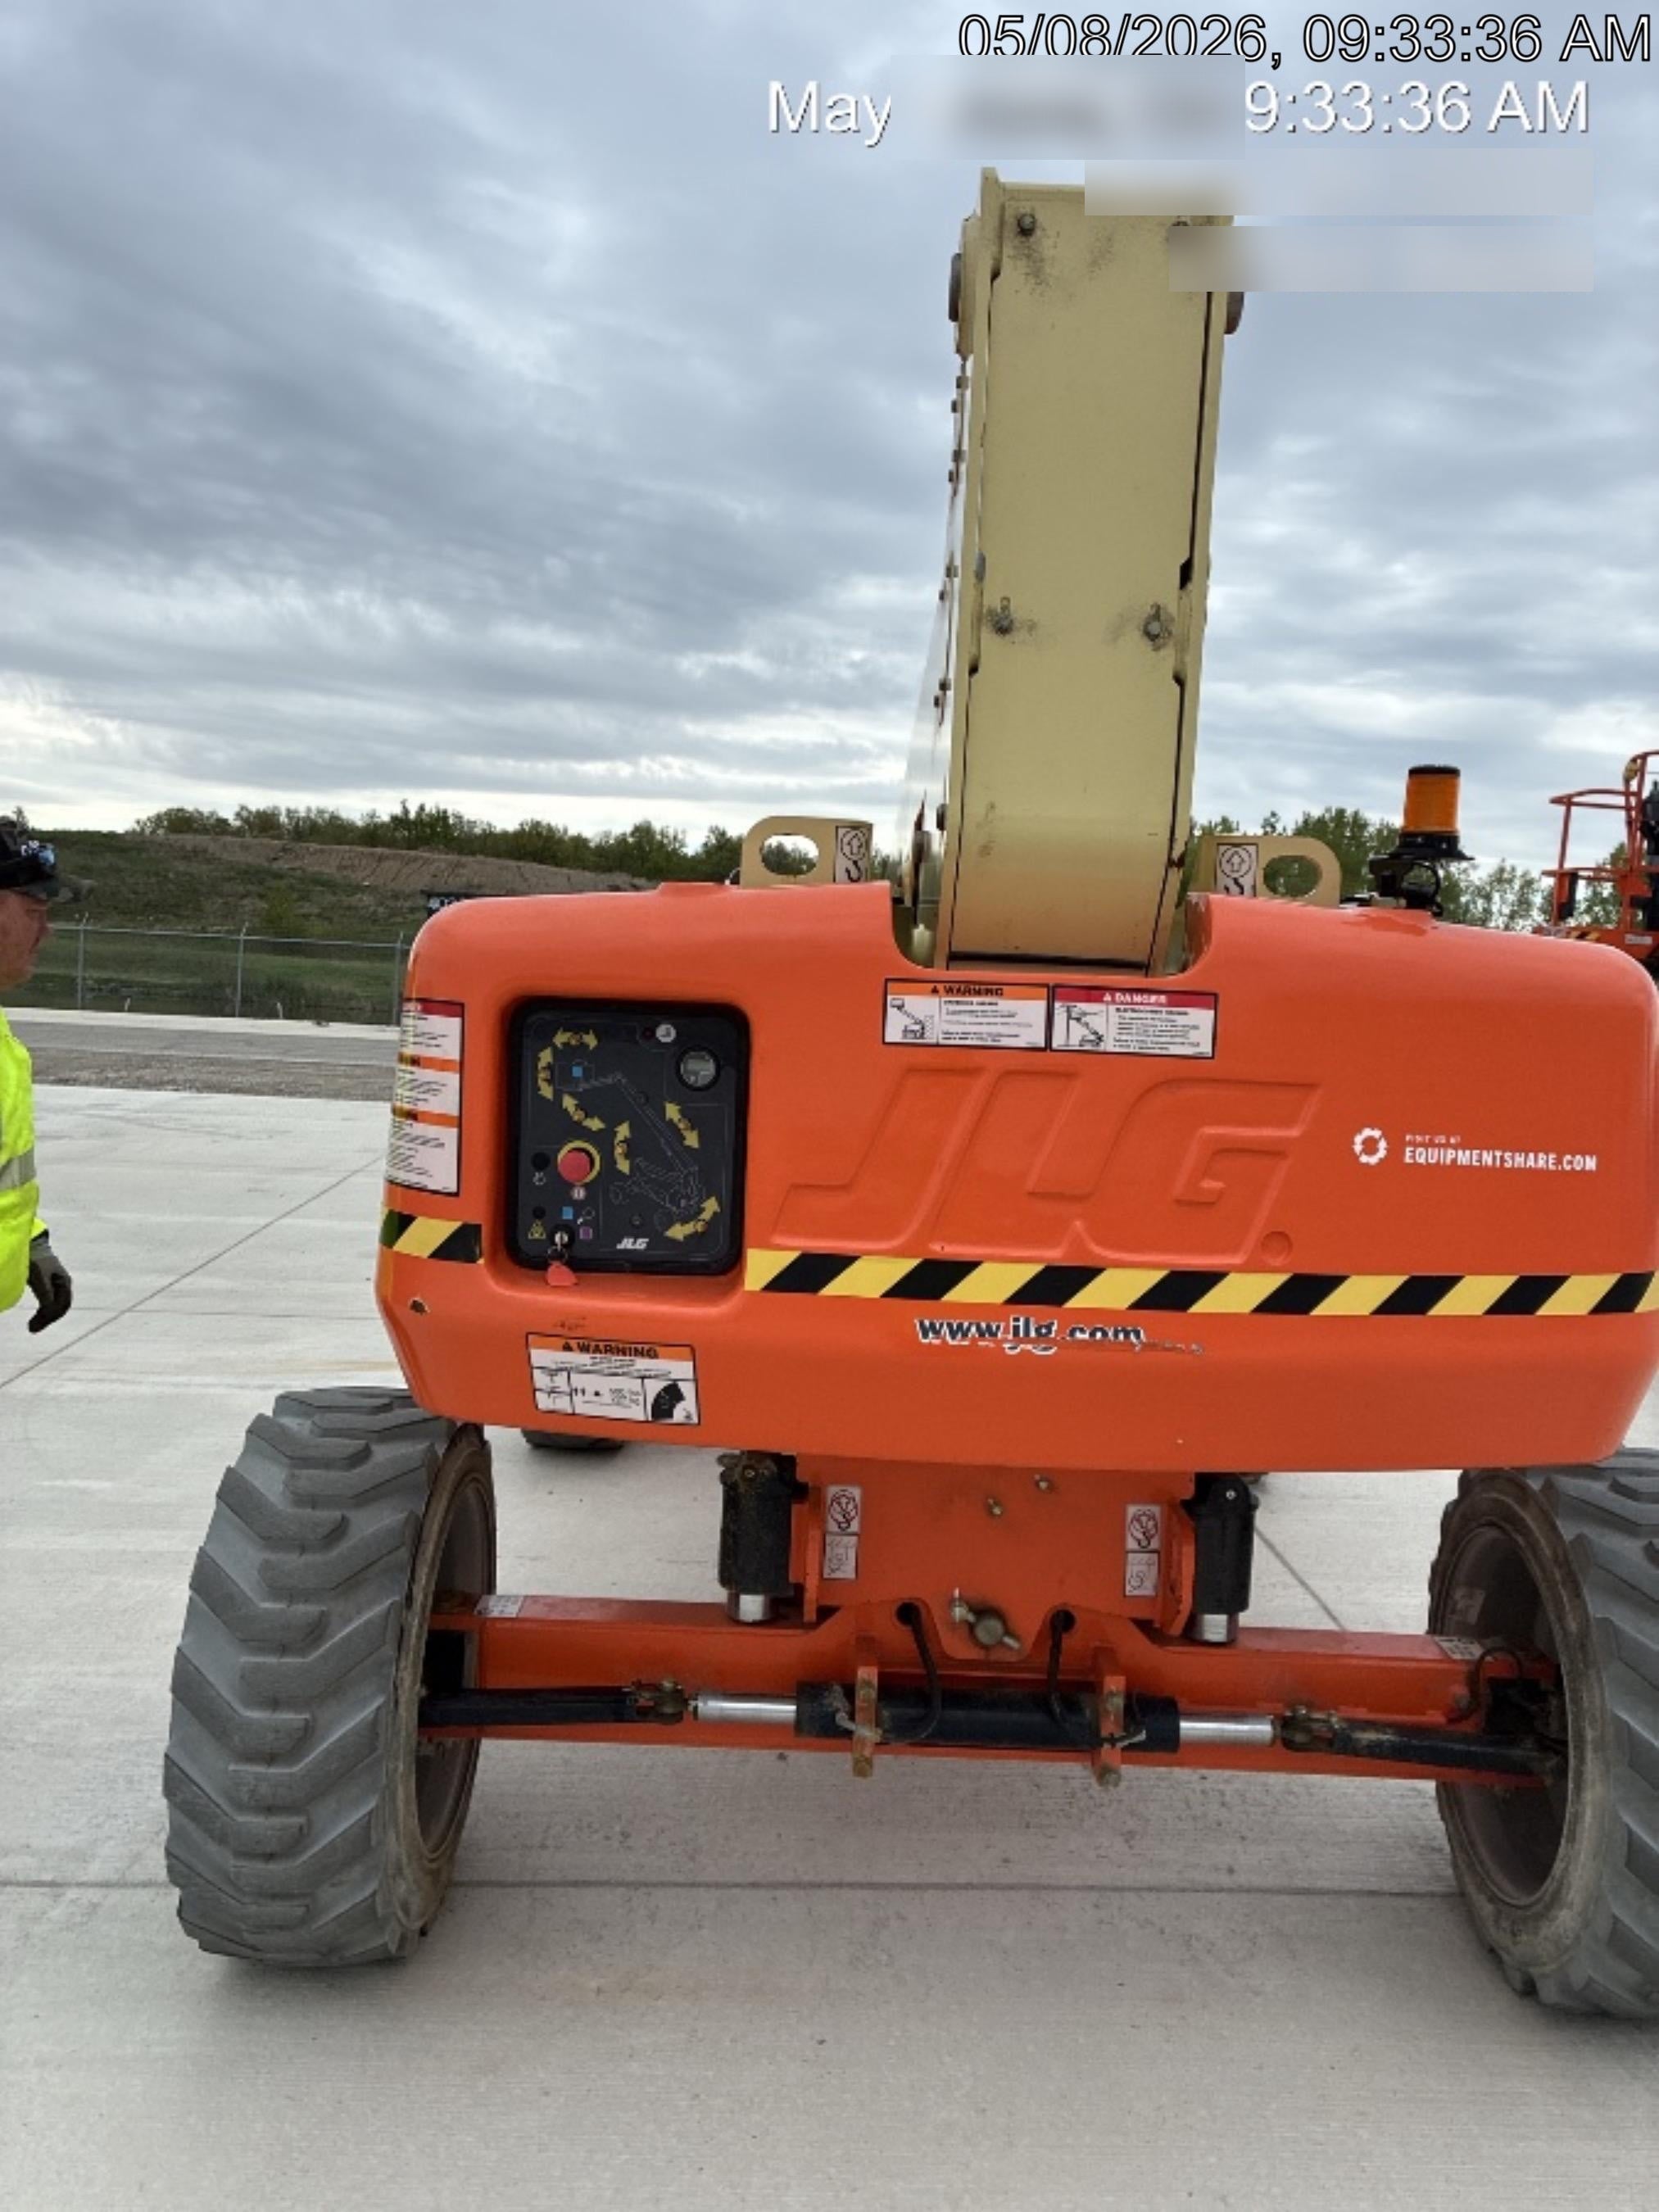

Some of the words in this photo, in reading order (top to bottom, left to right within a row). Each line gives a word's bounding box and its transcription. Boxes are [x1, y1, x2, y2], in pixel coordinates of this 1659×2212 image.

[943, 985, 1004, 997] WARNING
[1114, 991, 1167, 1004] DANGER
[771, 1067, 1321, 1264] JLG
[1403, 1146, 1598, 1172] EQUIPMENTSHARE.COM
[616, 1236, 650, 1250] JLG
[913, 1315, 1149, 1355] www.jlg.com
[577, 1341, 660, 1360] WARNING
